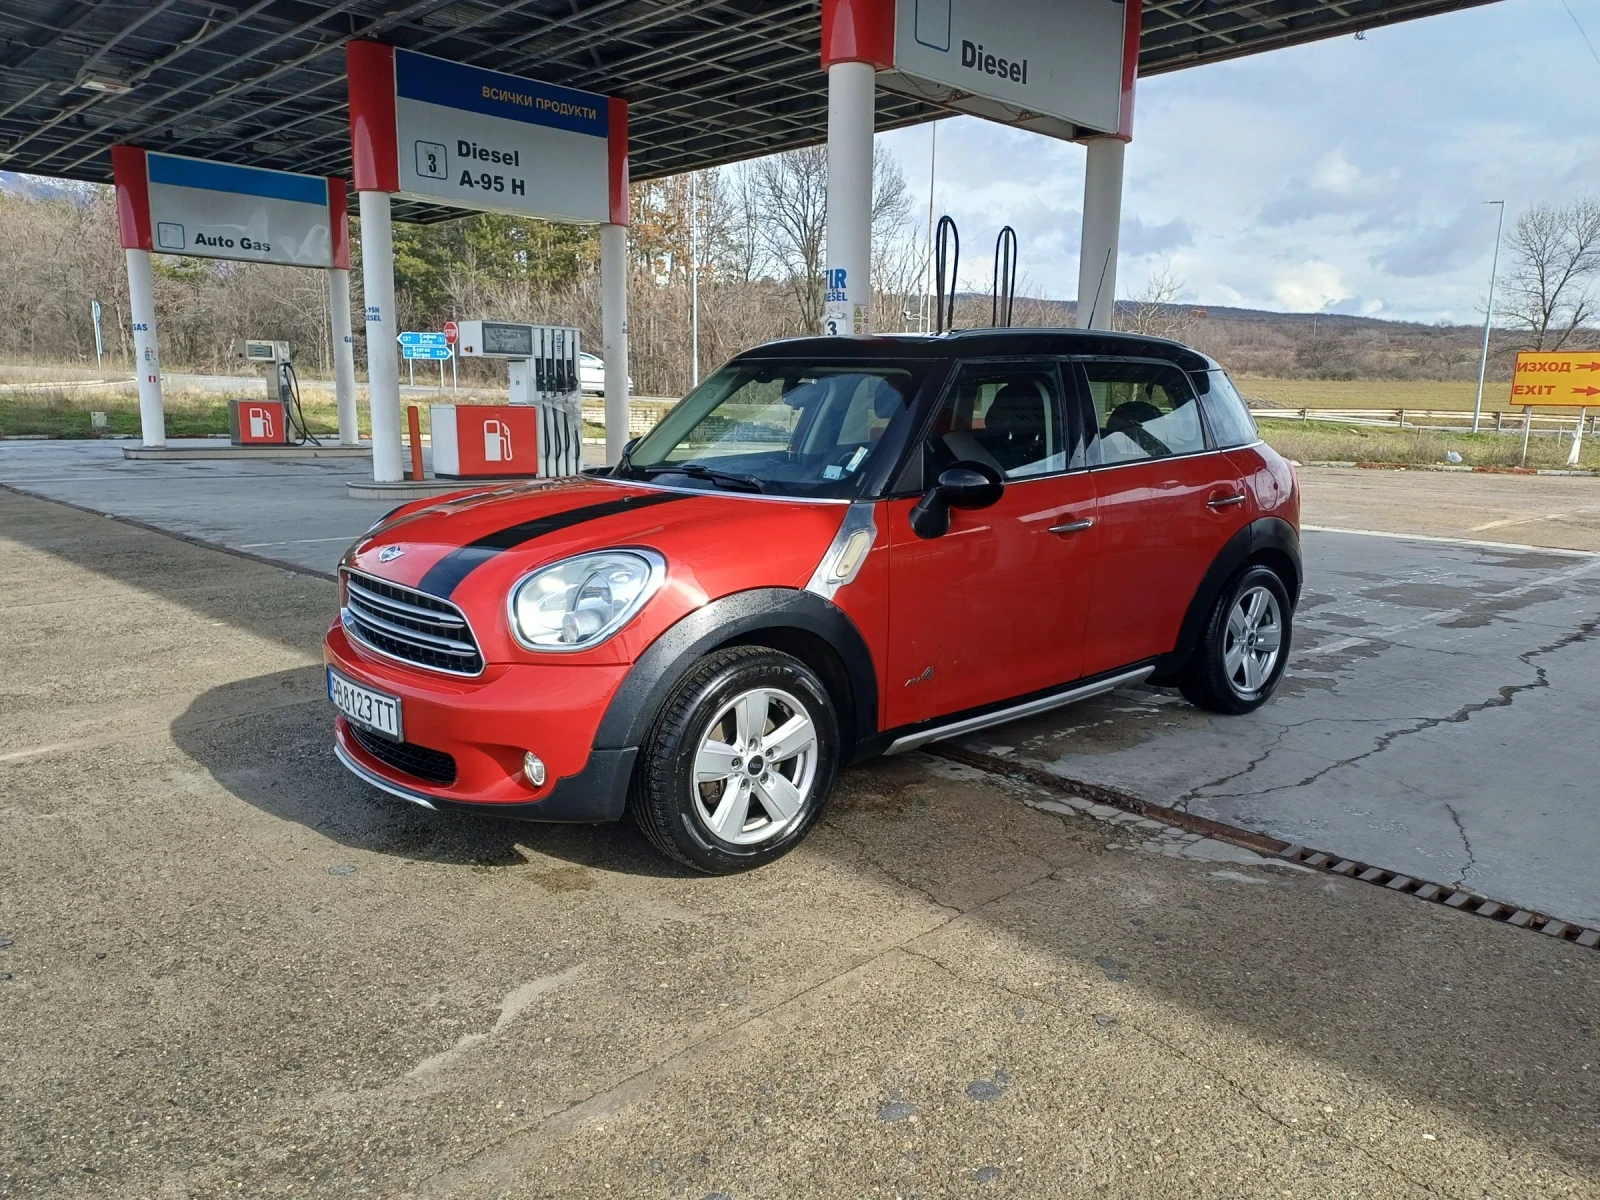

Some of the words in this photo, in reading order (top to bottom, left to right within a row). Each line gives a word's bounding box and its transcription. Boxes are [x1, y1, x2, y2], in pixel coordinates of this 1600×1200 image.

[961, 39, 1028, 85] Diesel
[482, 86, 533, 107] ВСИЧКИ
[535, 97, 598, 120] ПРОДУКТИ
[427, 153, 437, 173] 3
[457, 140, 519, 167] Diesel
[459, 170, 504, 193] A-95
[511, 178, 525, 196] H
[195, 232, 235, 249] Auto
[239, 237, 271, 252] Gas
[827, 320, 837, 336] 3
[1516, 362, 1571, 373] ИЗХОД
[1513, 385, 1556, 395] EXIT
